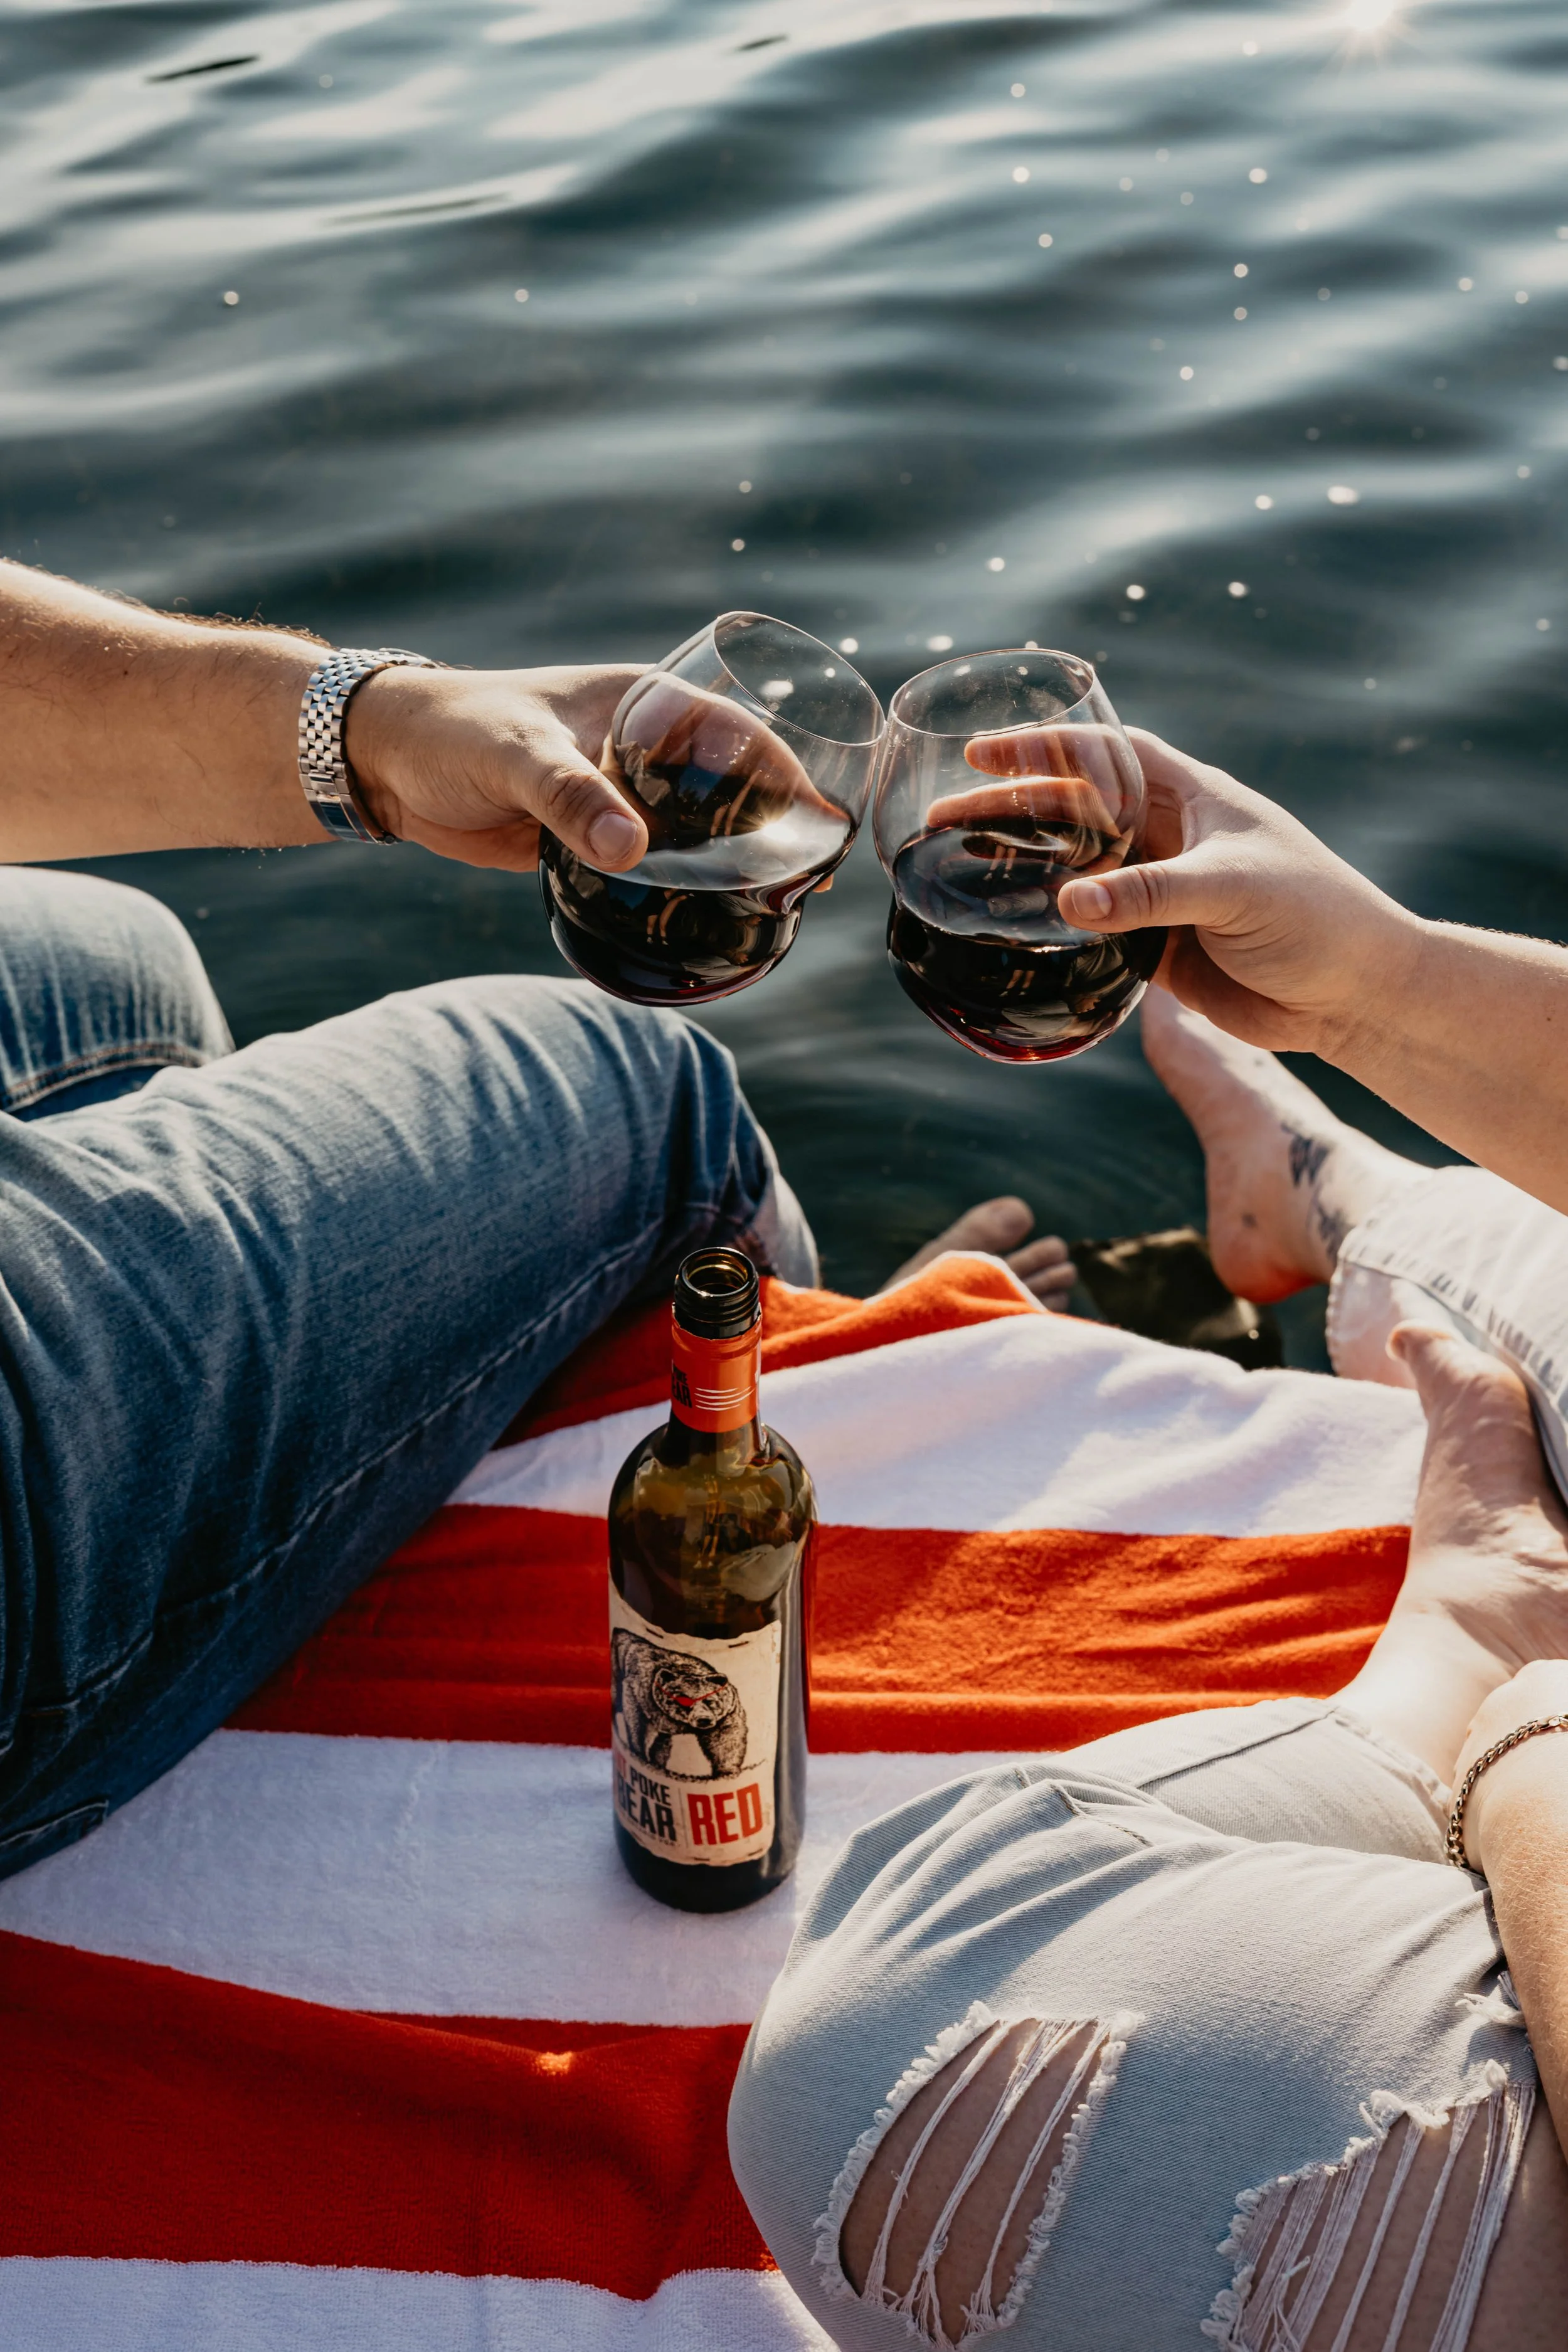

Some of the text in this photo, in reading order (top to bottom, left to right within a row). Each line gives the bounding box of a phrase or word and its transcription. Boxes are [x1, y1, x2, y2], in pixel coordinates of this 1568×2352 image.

[672, 1375, 692, 1409] EAR
[618, 1772, 676, 1841] BEAR
[630, 1766, 670, 1806] POKE
[687, 1783, 763, 1845] RED
